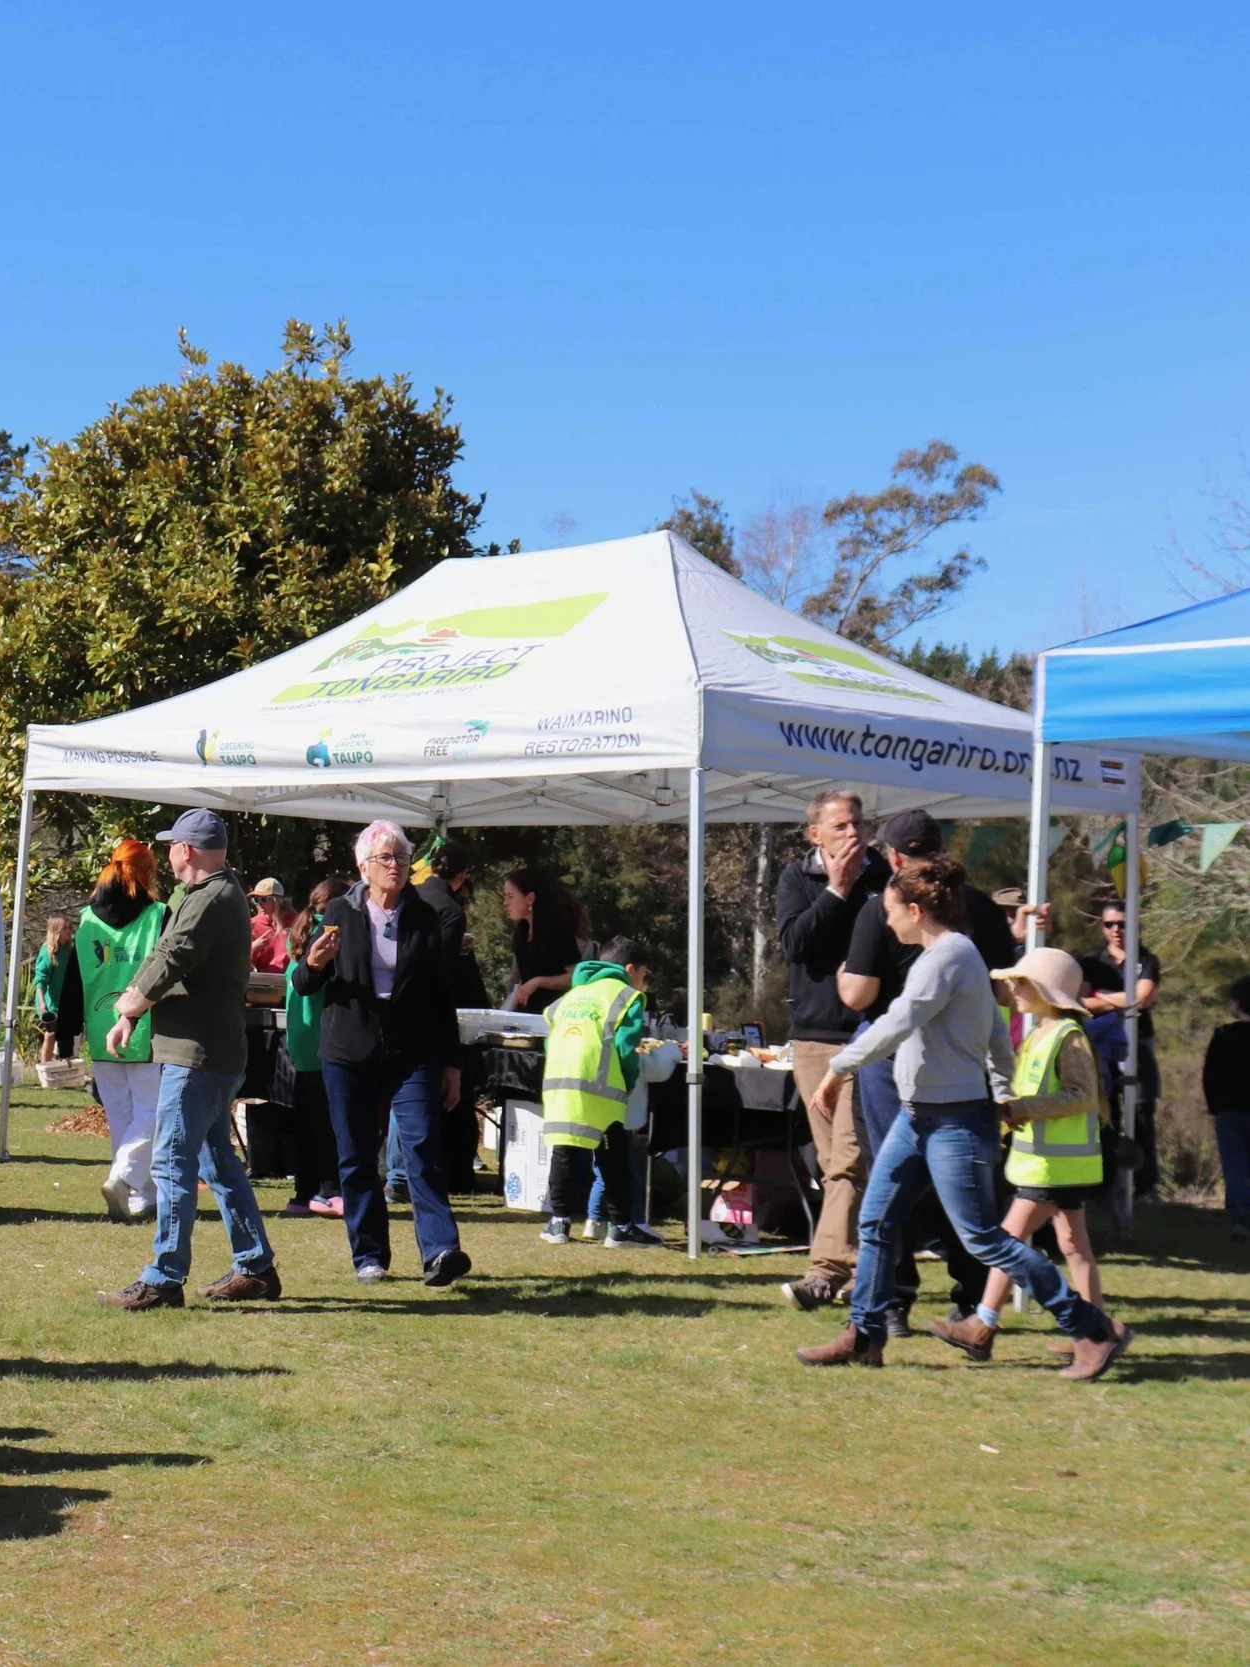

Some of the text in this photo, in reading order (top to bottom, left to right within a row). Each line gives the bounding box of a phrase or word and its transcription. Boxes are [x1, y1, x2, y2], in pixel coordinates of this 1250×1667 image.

[370, 644, 548, 675] PROJECT
[310, 662, 520, 698] TONGARIRO
[537, 706, 633, 731] WAIMARINO
[423, 745, 449, 758] FREE
[425, 734, 481, 746] PREDATOR
[523, 733, 642, 756] RESTORATION
[779, 721, 1083, 782] www.tongariro.or.nz
[106, 750, 163, 764] POSSIBLE
